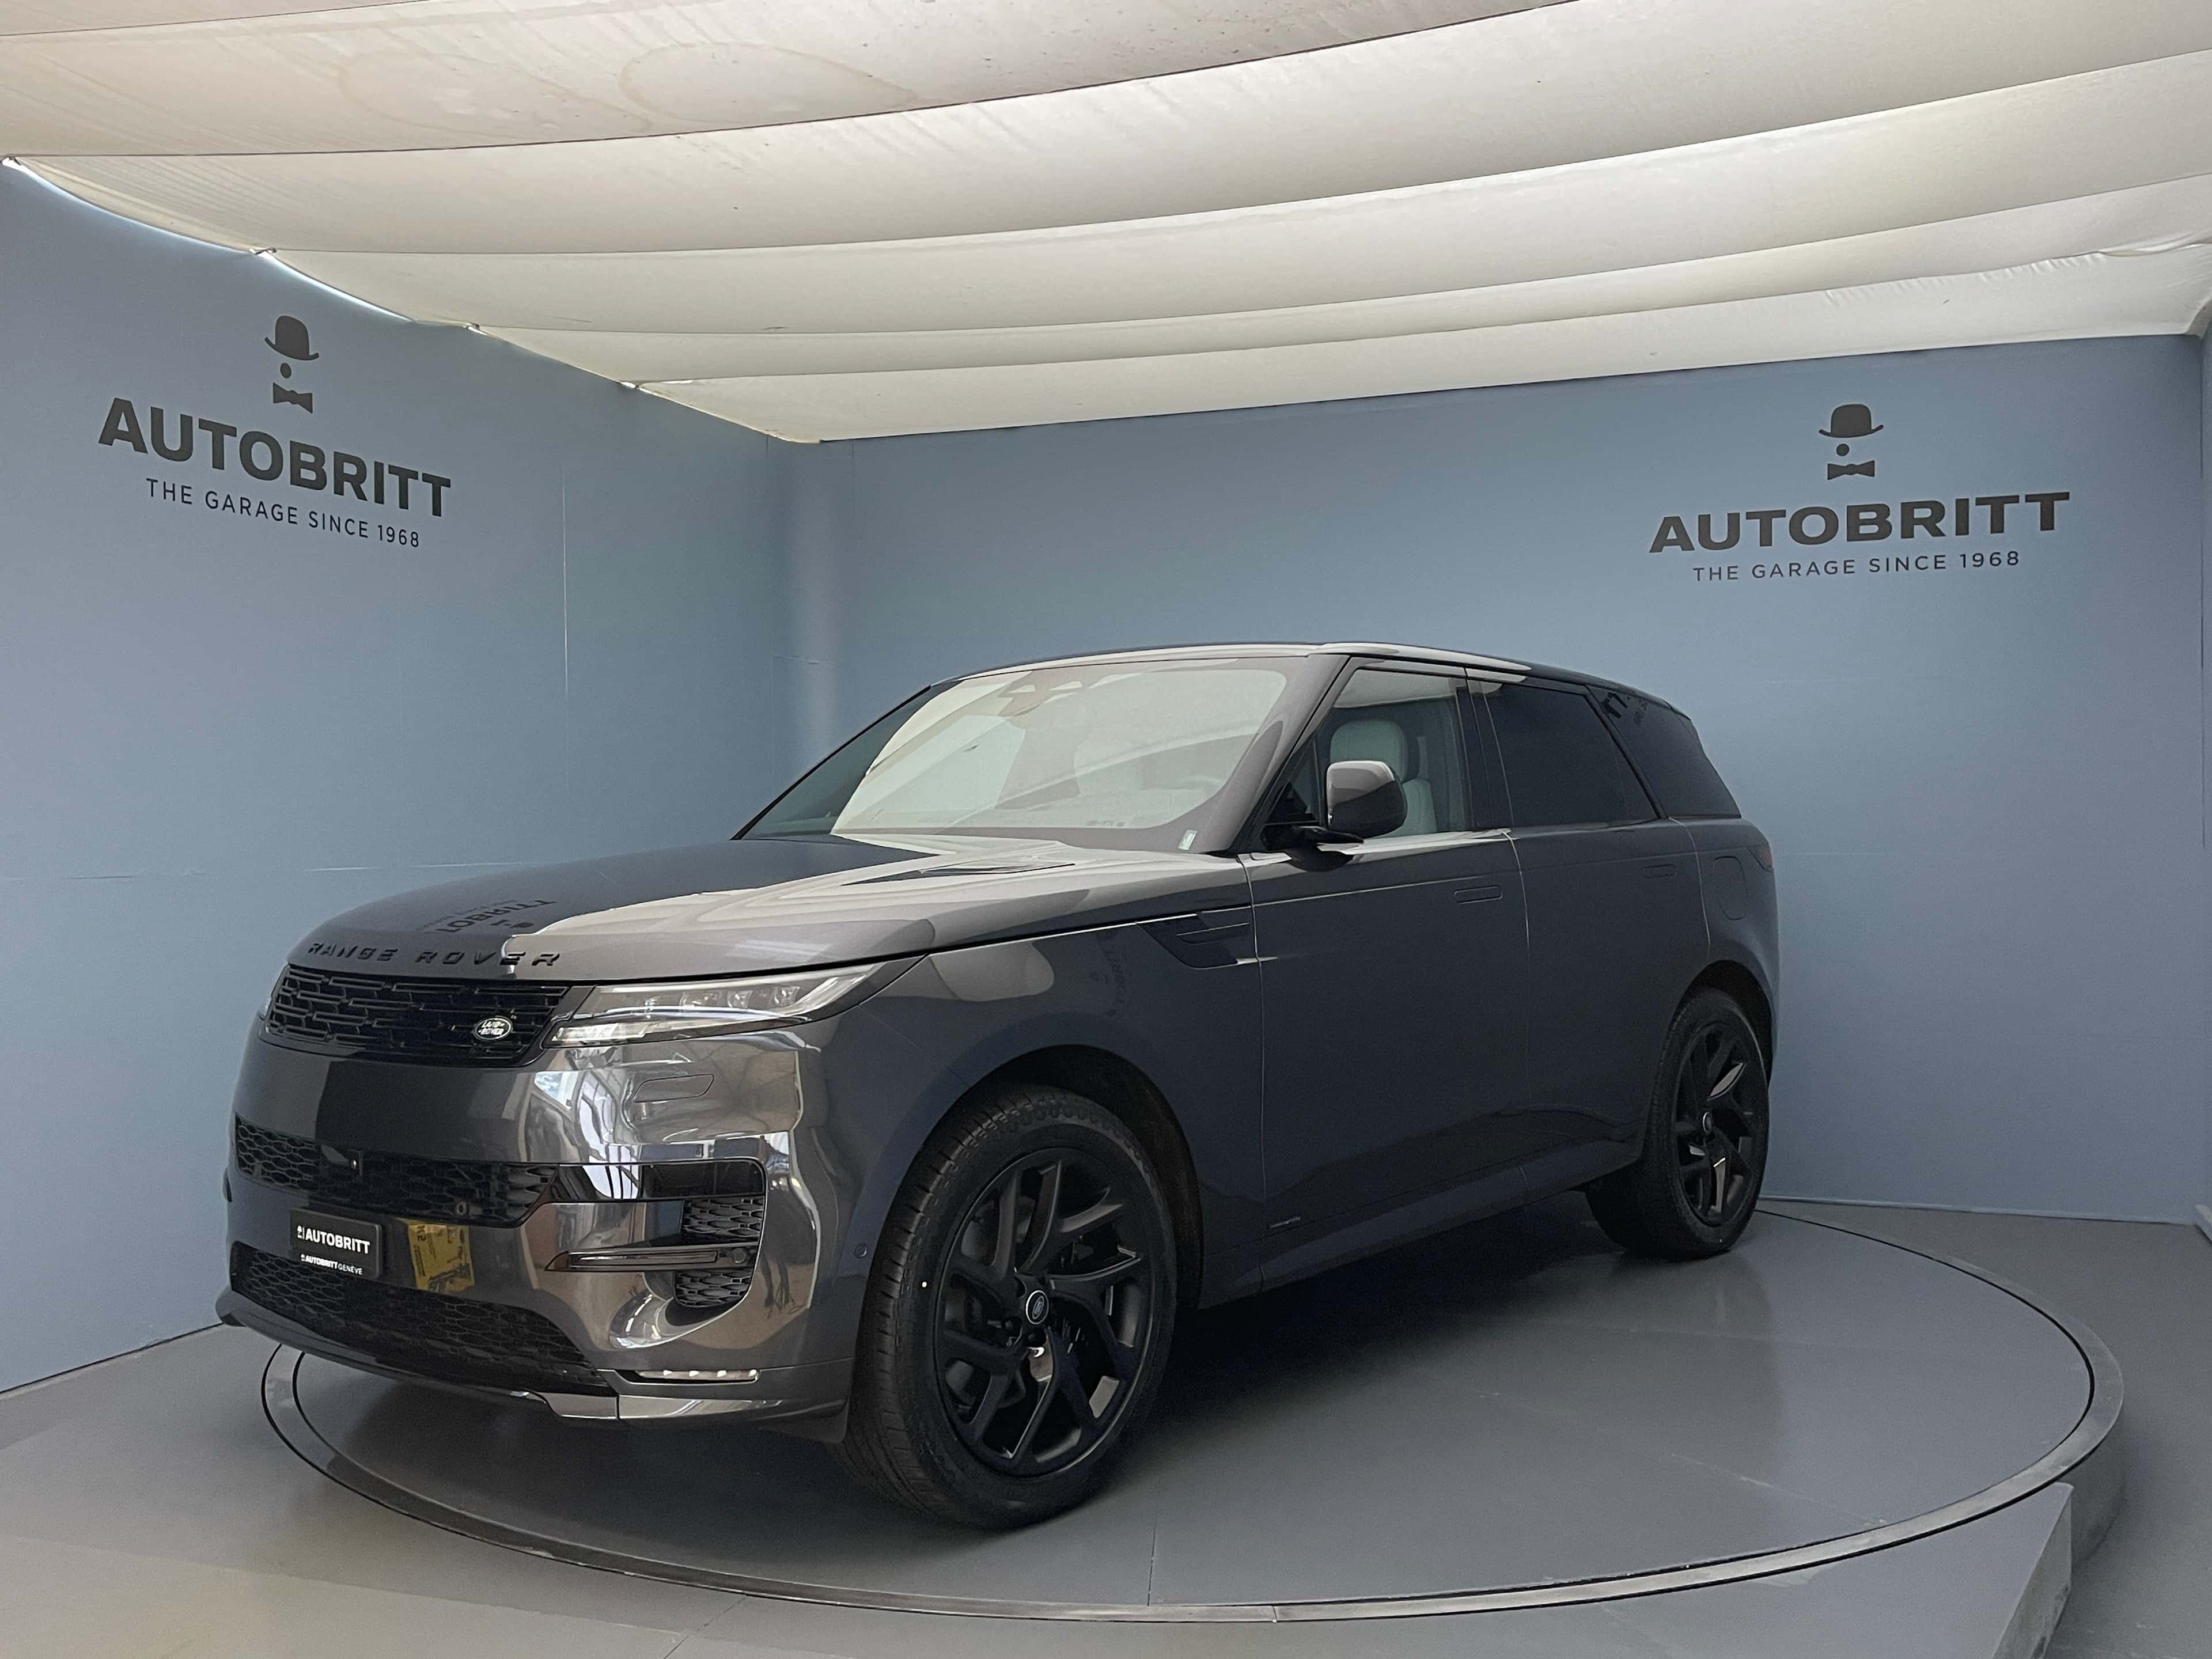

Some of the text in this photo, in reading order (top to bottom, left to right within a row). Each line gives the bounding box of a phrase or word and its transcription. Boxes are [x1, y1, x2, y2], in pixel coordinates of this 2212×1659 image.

[99, 397, 451, 517] AUTOBRITT
[146, 478, 420, 548] THE GARAGE SINCE 1968
[1649, 491, 2070, 553] AUTOBRITT
[1693, 551, 2020, 582] THE GARAGE SINCE 1968
[307, 942, 560, 967] RANGE ROVER
[305, 1228, 370, 1254] AUTOBRITT
